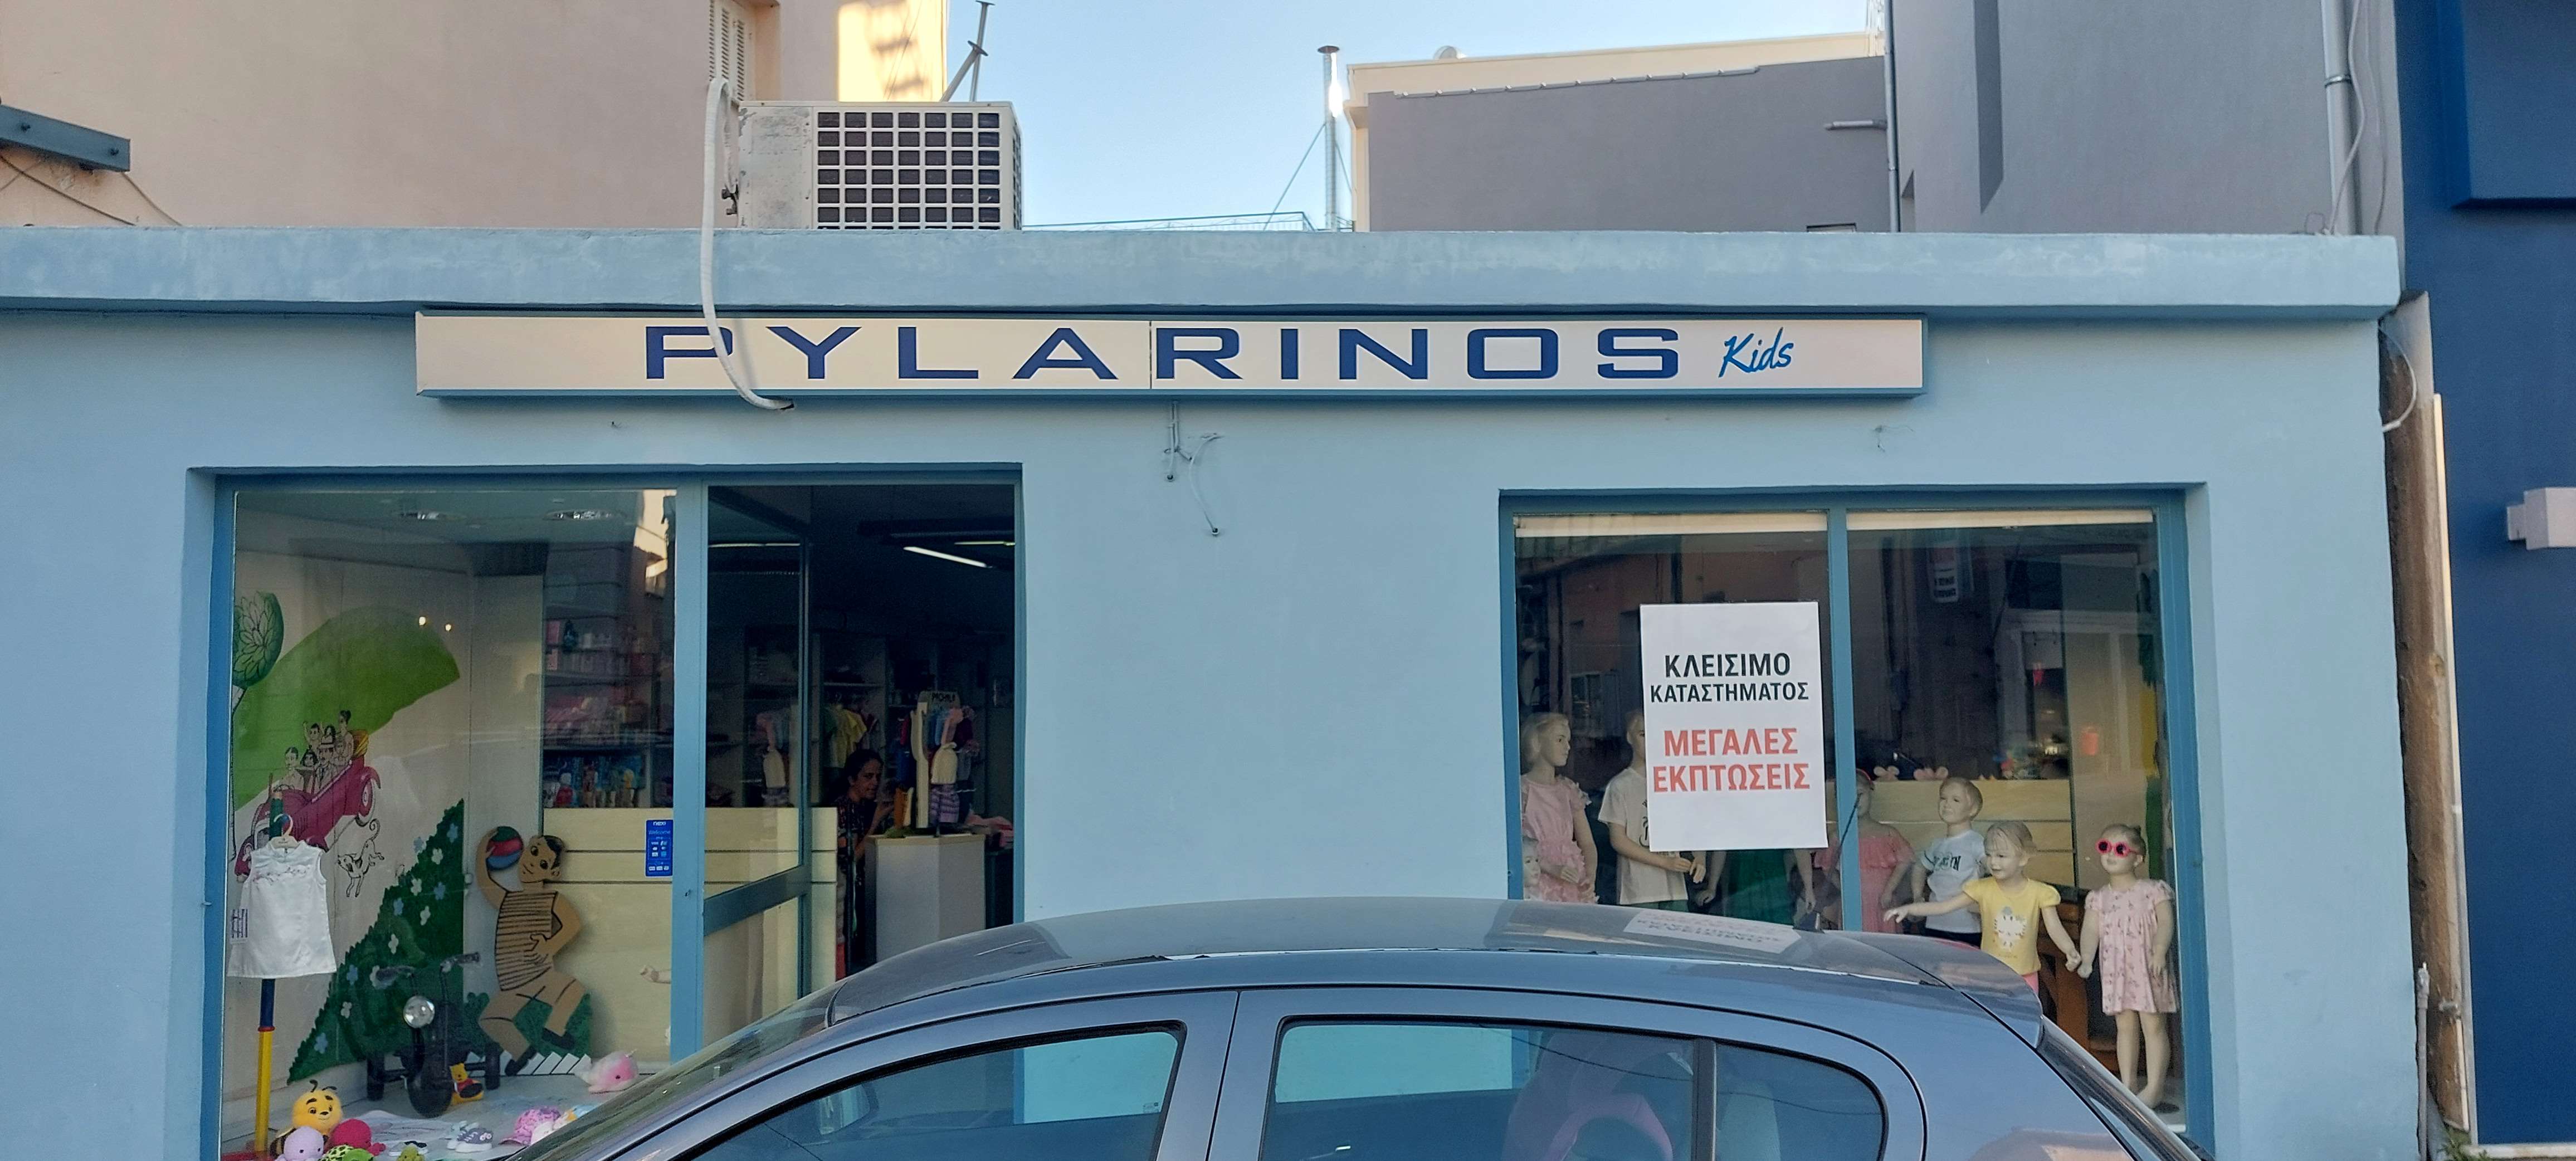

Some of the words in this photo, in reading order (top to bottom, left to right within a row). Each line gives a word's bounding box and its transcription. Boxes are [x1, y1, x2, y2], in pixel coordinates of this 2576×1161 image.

[646, 326, 1679, 380] PYLARINOS
[1718, 326, 1794, 378] Kids
[1665, 652, 1790, 678] ΚΛΕΙΣΙΜΟ
[1650, 682, 1809, 703] ΚΑΤΑΣΤΗΜΑΤΟΣ
[1664, 728, 1798, 757] ΜΕΓΑΛΕΣ
[1653, 763, 1810, 793] ΕΚΠΤΩΣΕΙΣ
